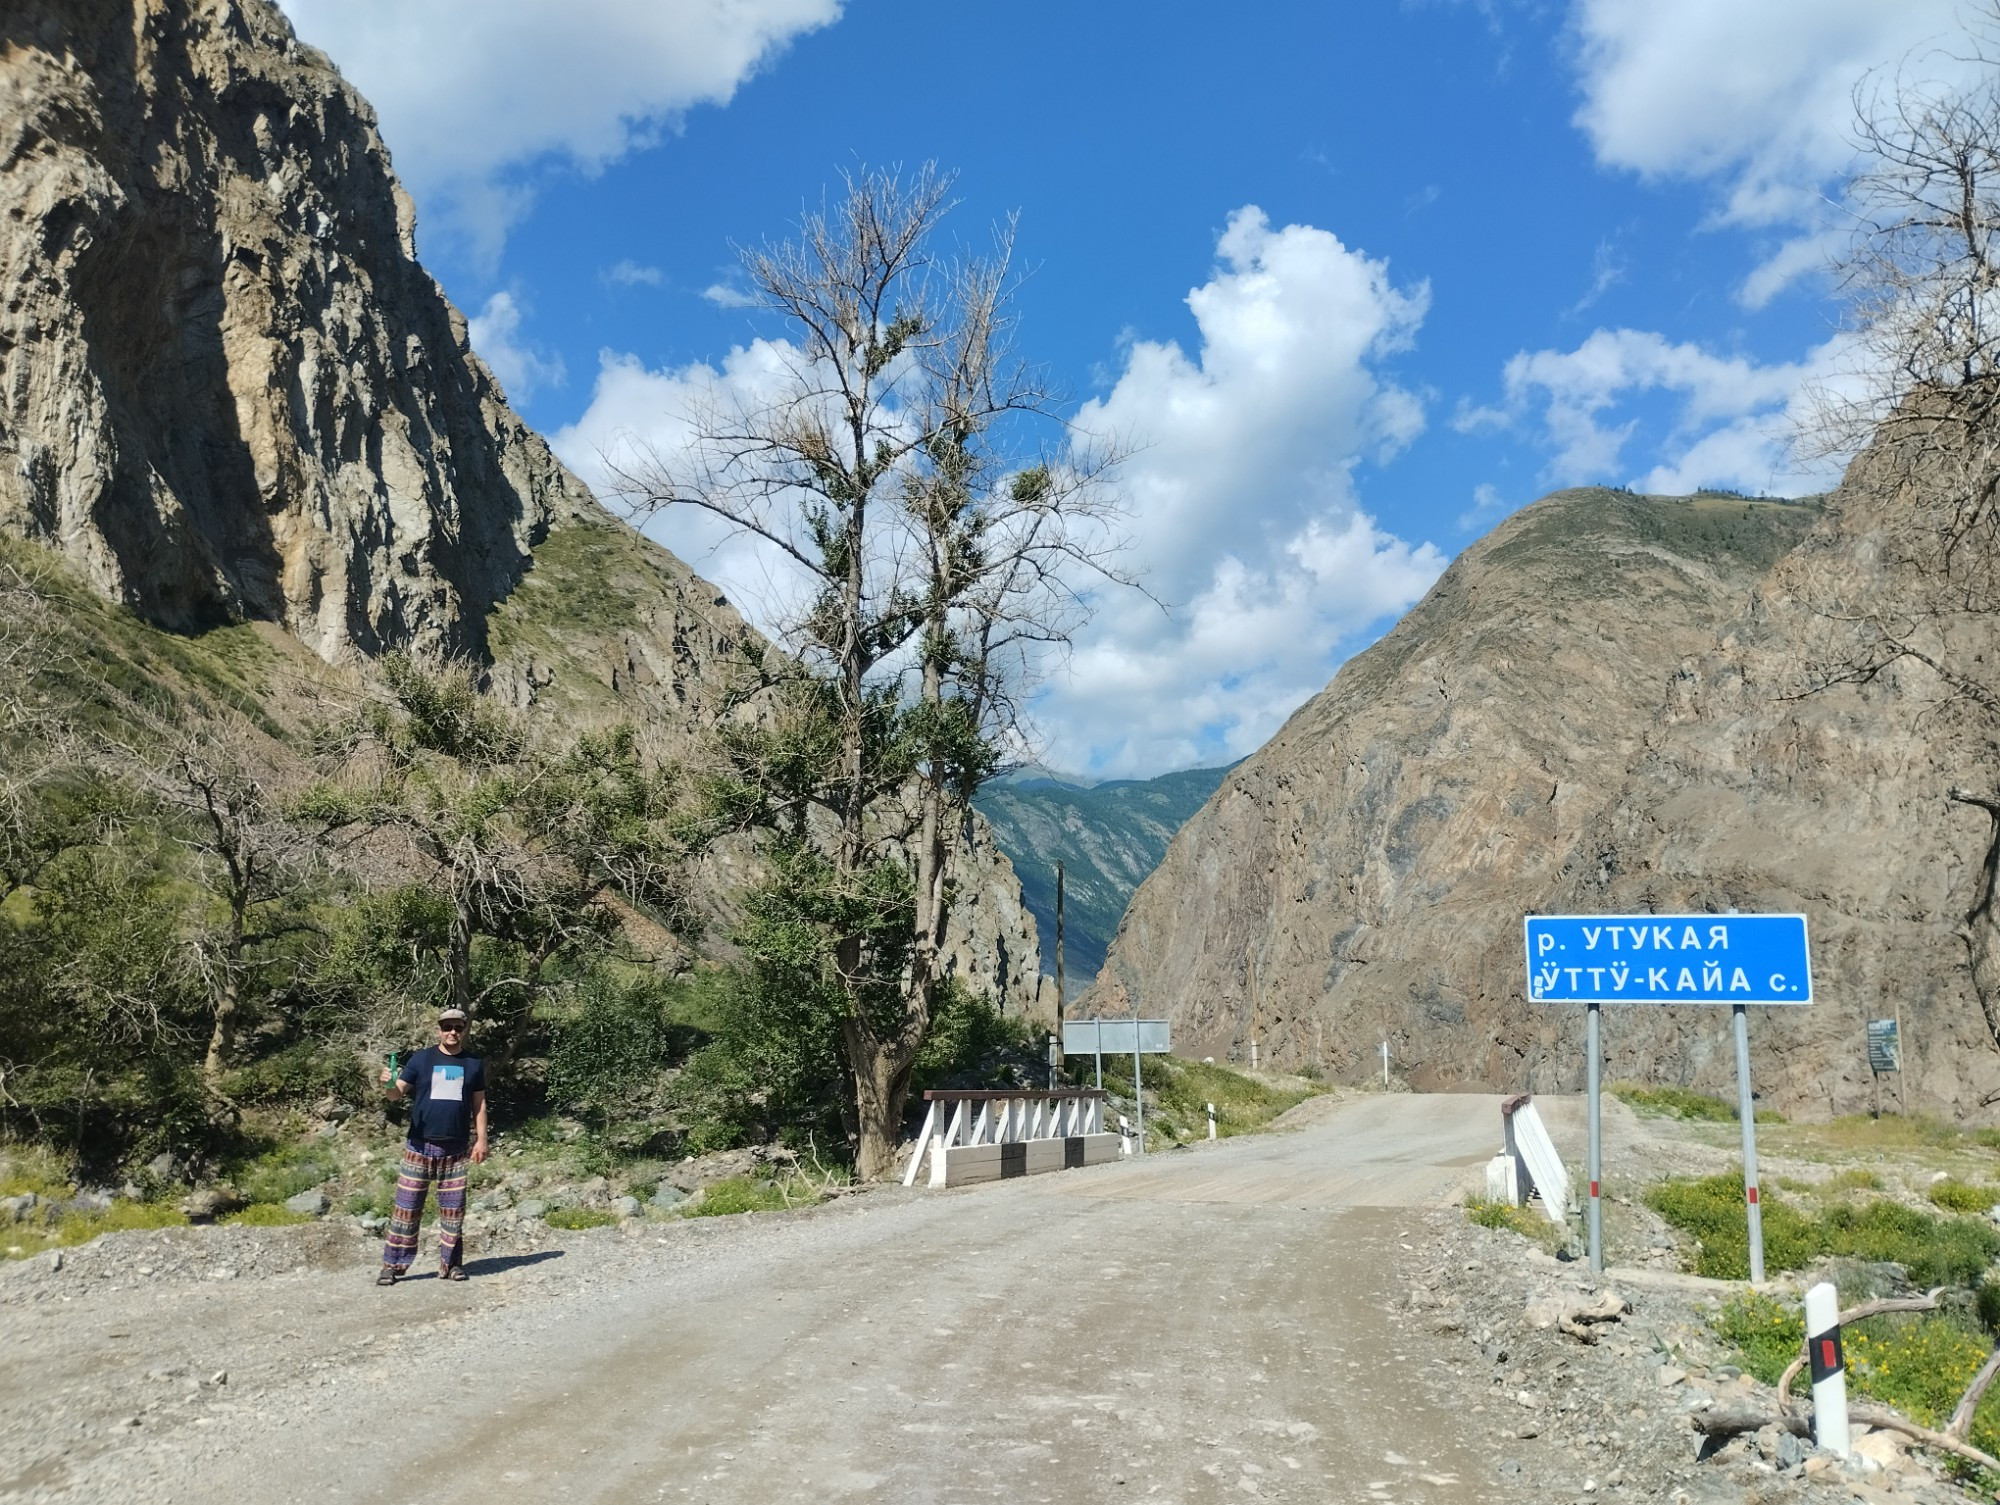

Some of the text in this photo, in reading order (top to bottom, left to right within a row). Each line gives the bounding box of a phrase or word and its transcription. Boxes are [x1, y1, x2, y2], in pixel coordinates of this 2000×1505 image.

[1538, 925, 1729, 956] р. УТУКАЯ
[1540, 960, 1798, 991] ӰТТӰ-КАЙА с.
